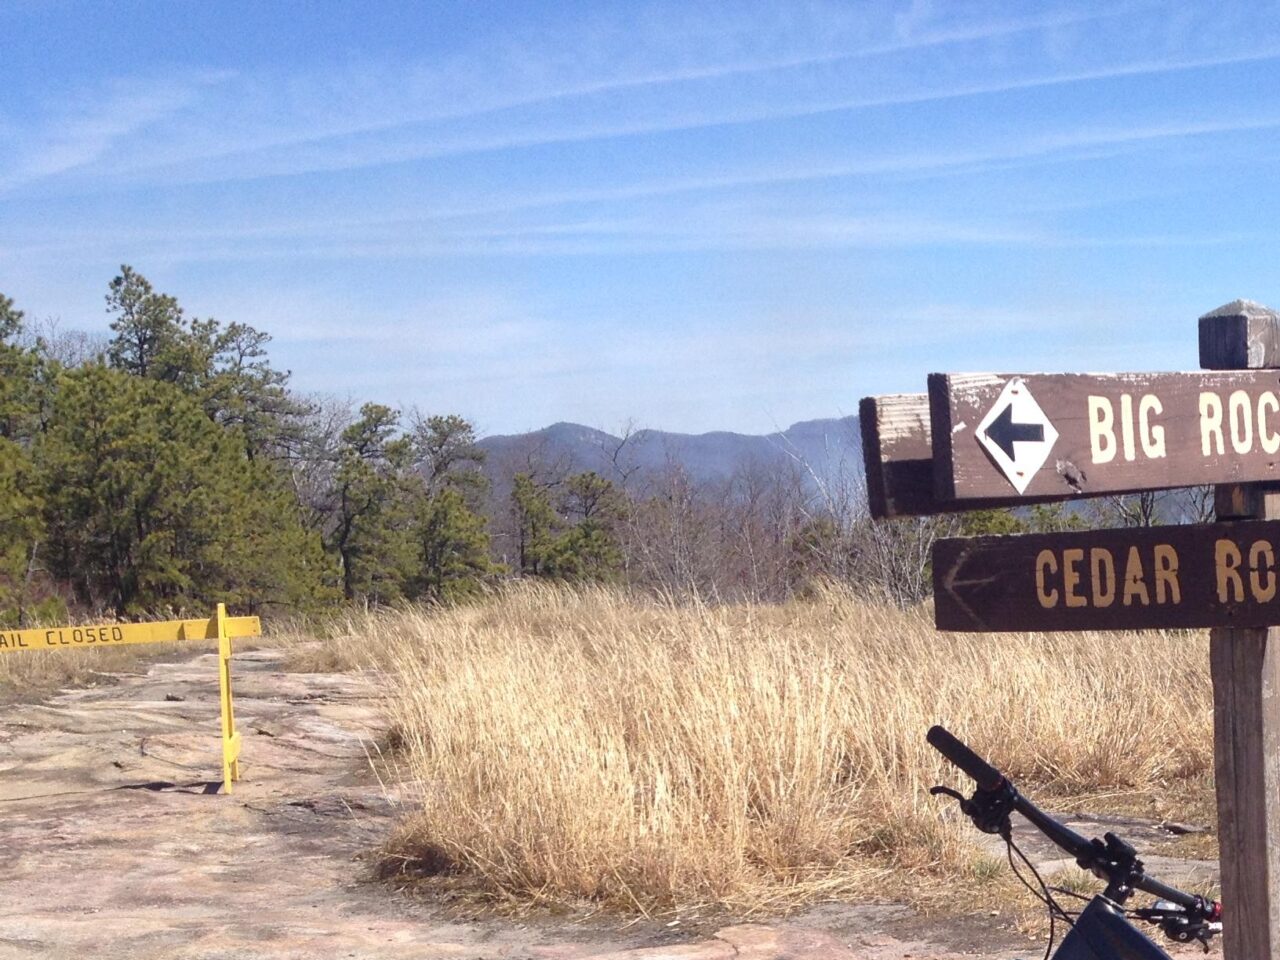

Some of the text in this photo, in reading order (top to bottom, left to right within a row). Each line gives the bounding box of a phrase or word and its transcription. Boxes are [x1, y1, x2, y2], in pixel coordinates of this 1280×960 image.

[1088, 393, 1167, 465] BIG
[1035, 546, 1181, 609] CEDAR
[46, 627, 123, 645] CLOSED
